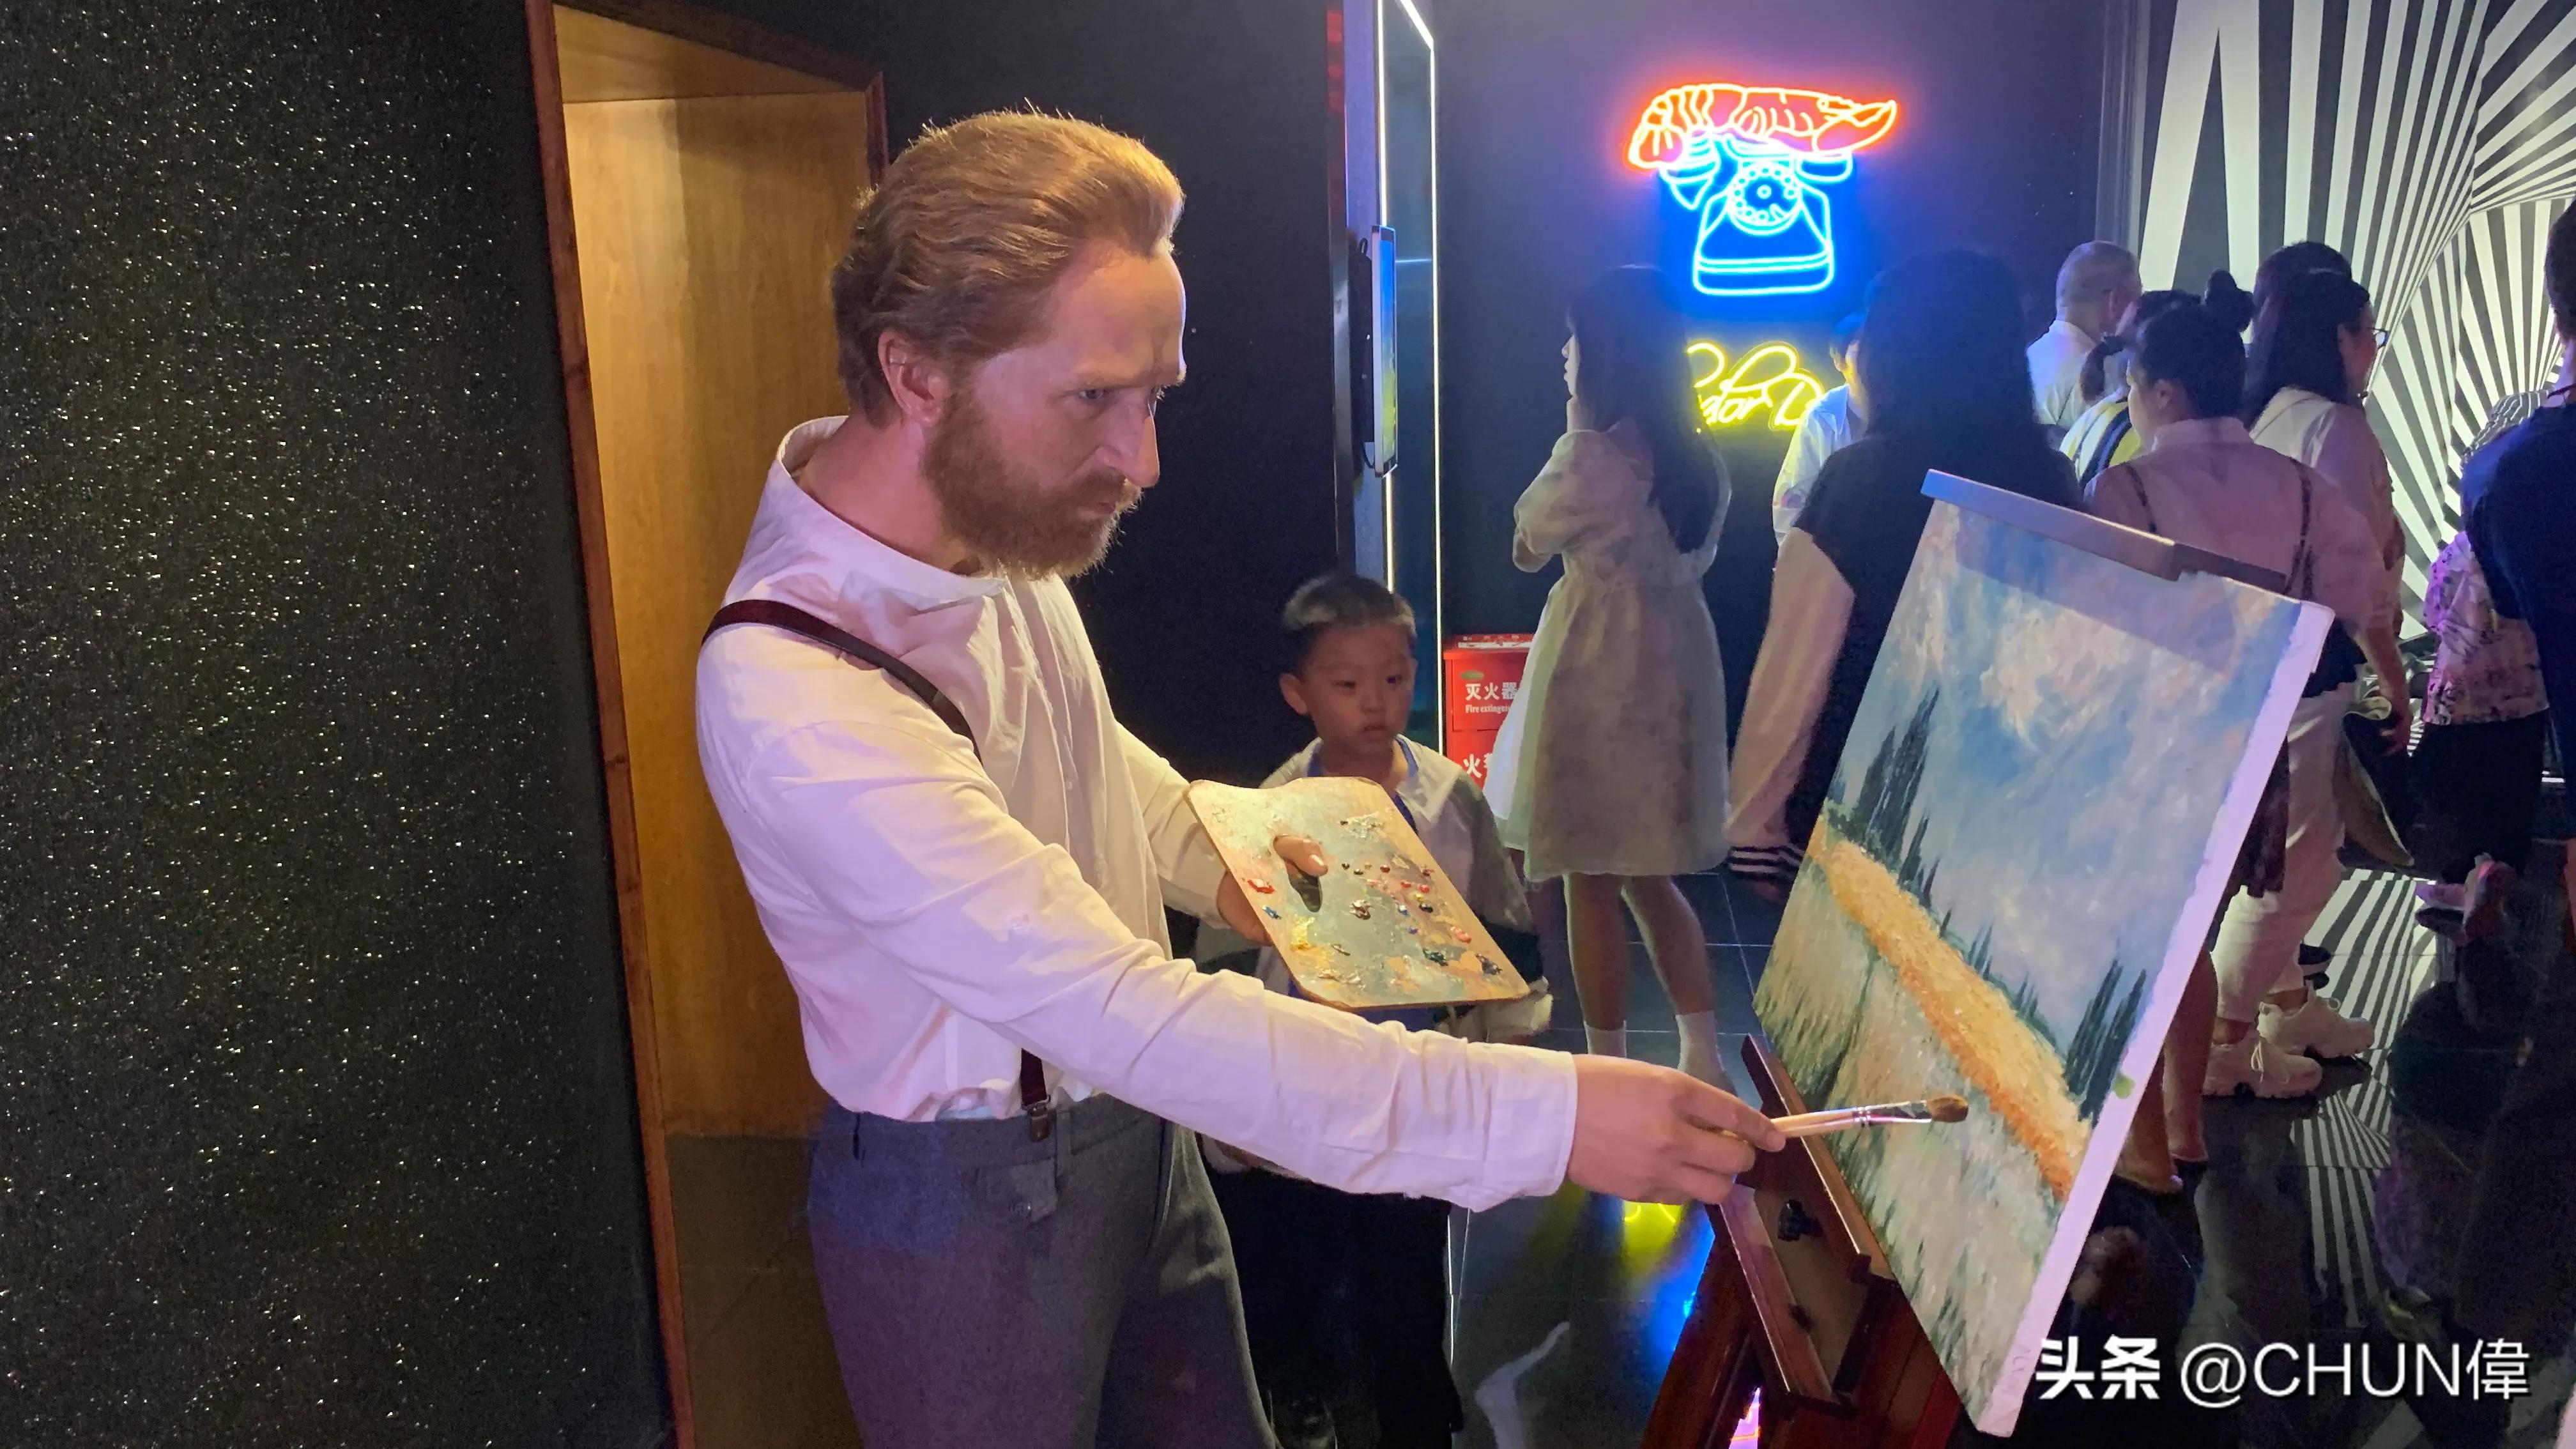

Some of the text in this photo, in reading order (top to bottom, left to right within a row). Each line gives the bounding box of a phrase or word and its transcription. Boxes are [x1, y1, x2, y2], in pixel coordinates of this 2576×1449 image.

[1465, 682, 1517, 701] 灭火器
[1465, 704, 1480, 714] Fire
